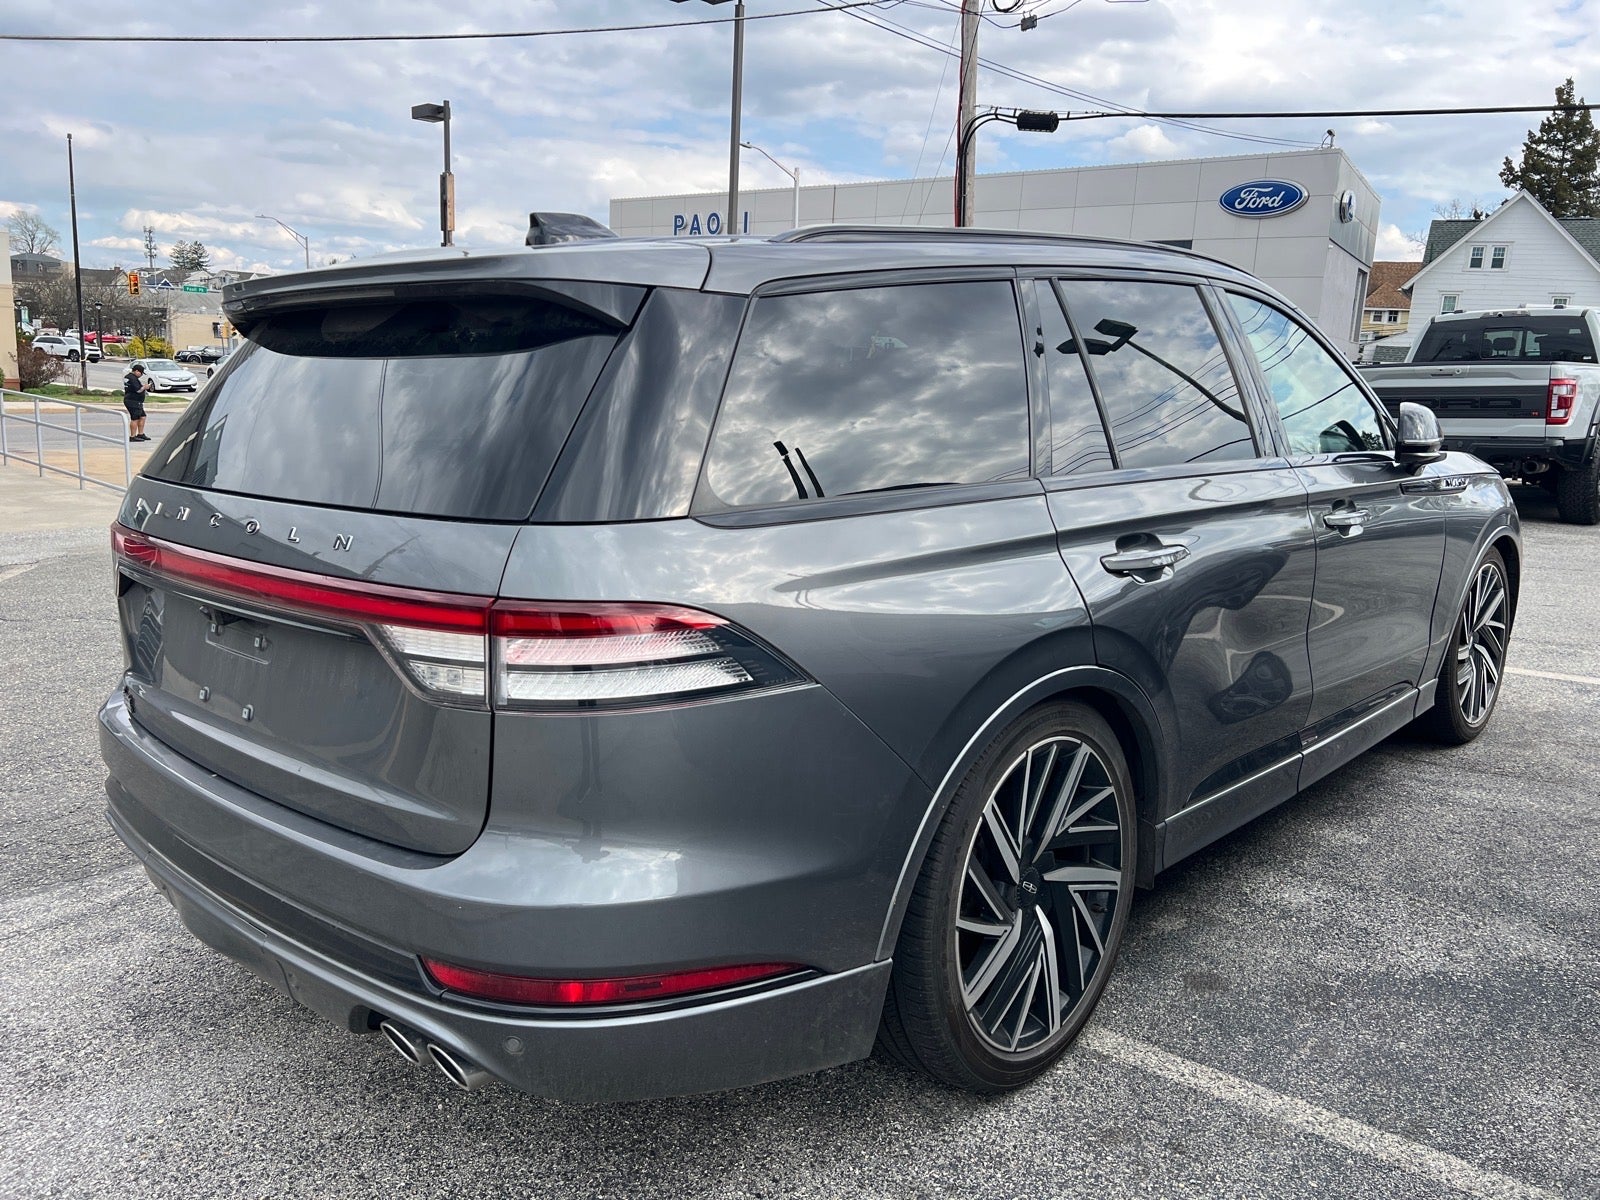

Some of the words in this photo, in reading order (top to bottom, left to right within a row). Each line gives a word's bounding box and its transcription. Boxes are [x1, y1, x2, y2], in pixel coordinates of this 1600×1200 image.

[1234, 187, 1285, 209] Ford
[673, 211, 749, 236] PAOI
[135, 497, 354, 552] LINCOLN
